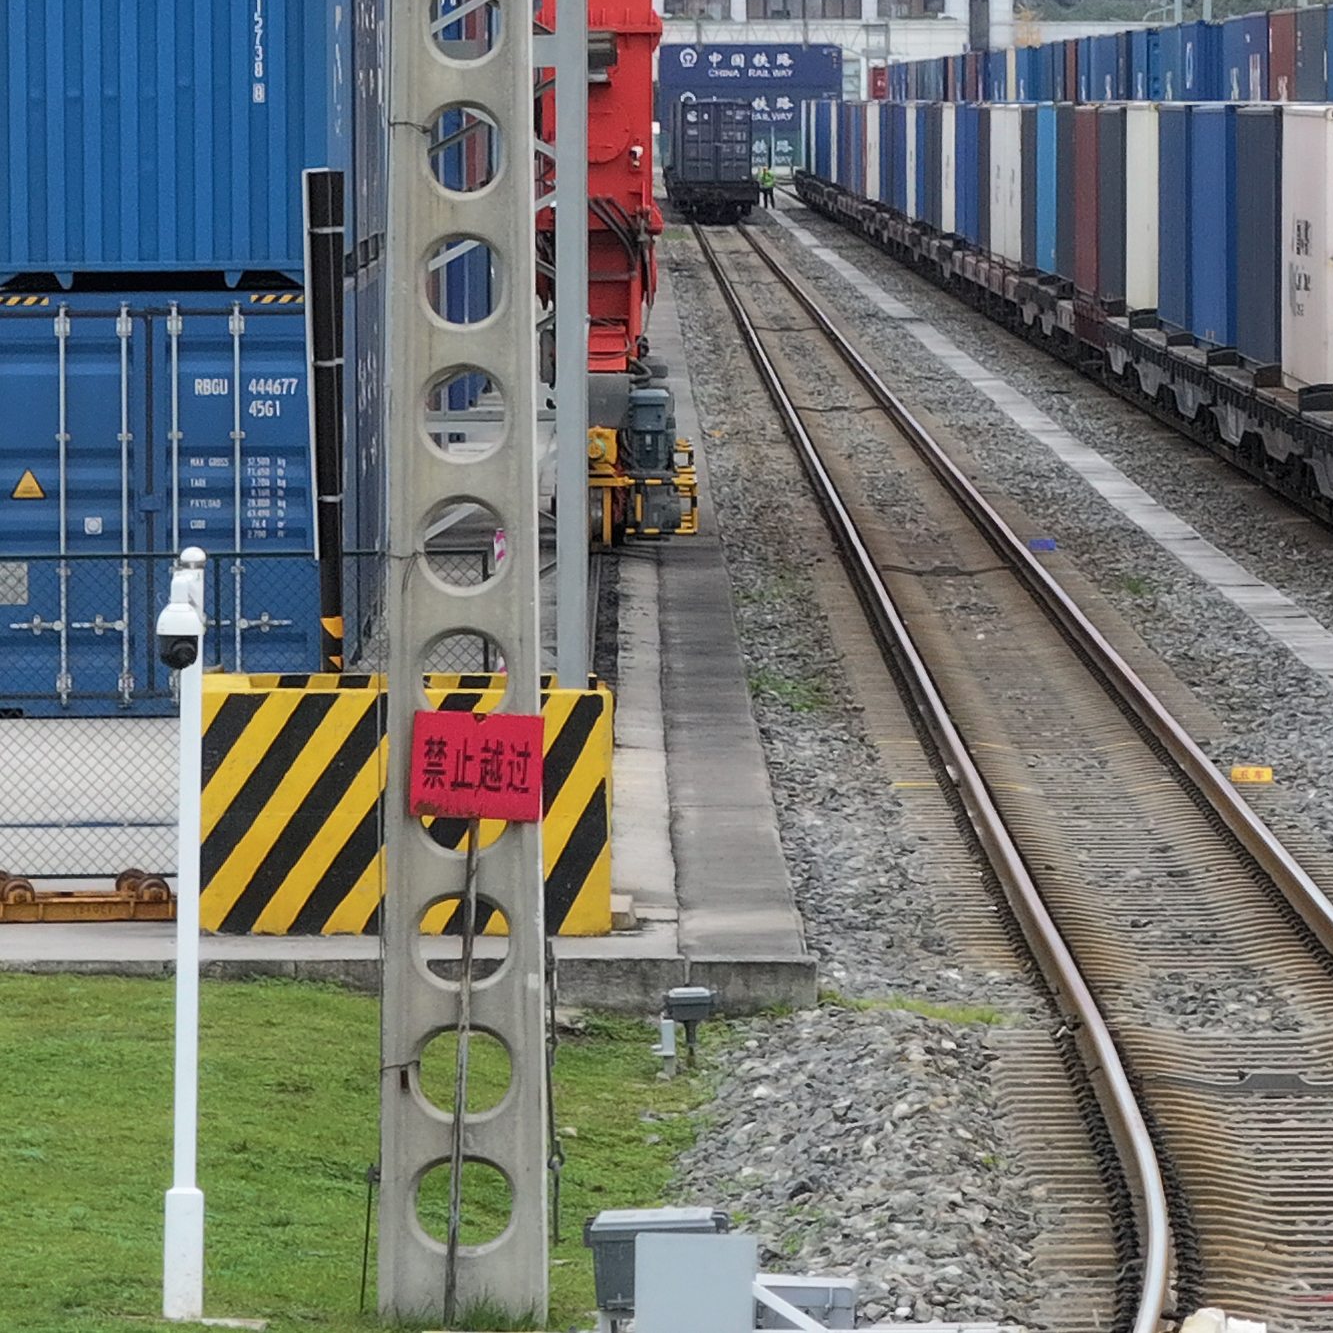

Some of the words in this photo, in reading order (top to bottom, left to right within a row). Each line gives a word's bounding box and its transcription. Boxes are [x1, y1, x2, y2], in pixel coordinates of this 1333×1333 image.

[708, 51, 794, 68] 中国铁路
[708, 69, 741, 78] CHINA
[194, 378, 229, 396] RBGU
[248, 378, 299, 396] 444677
[248, 400, 281, 417] 45G1
[421, 735, 532, 797] 禁止越过
